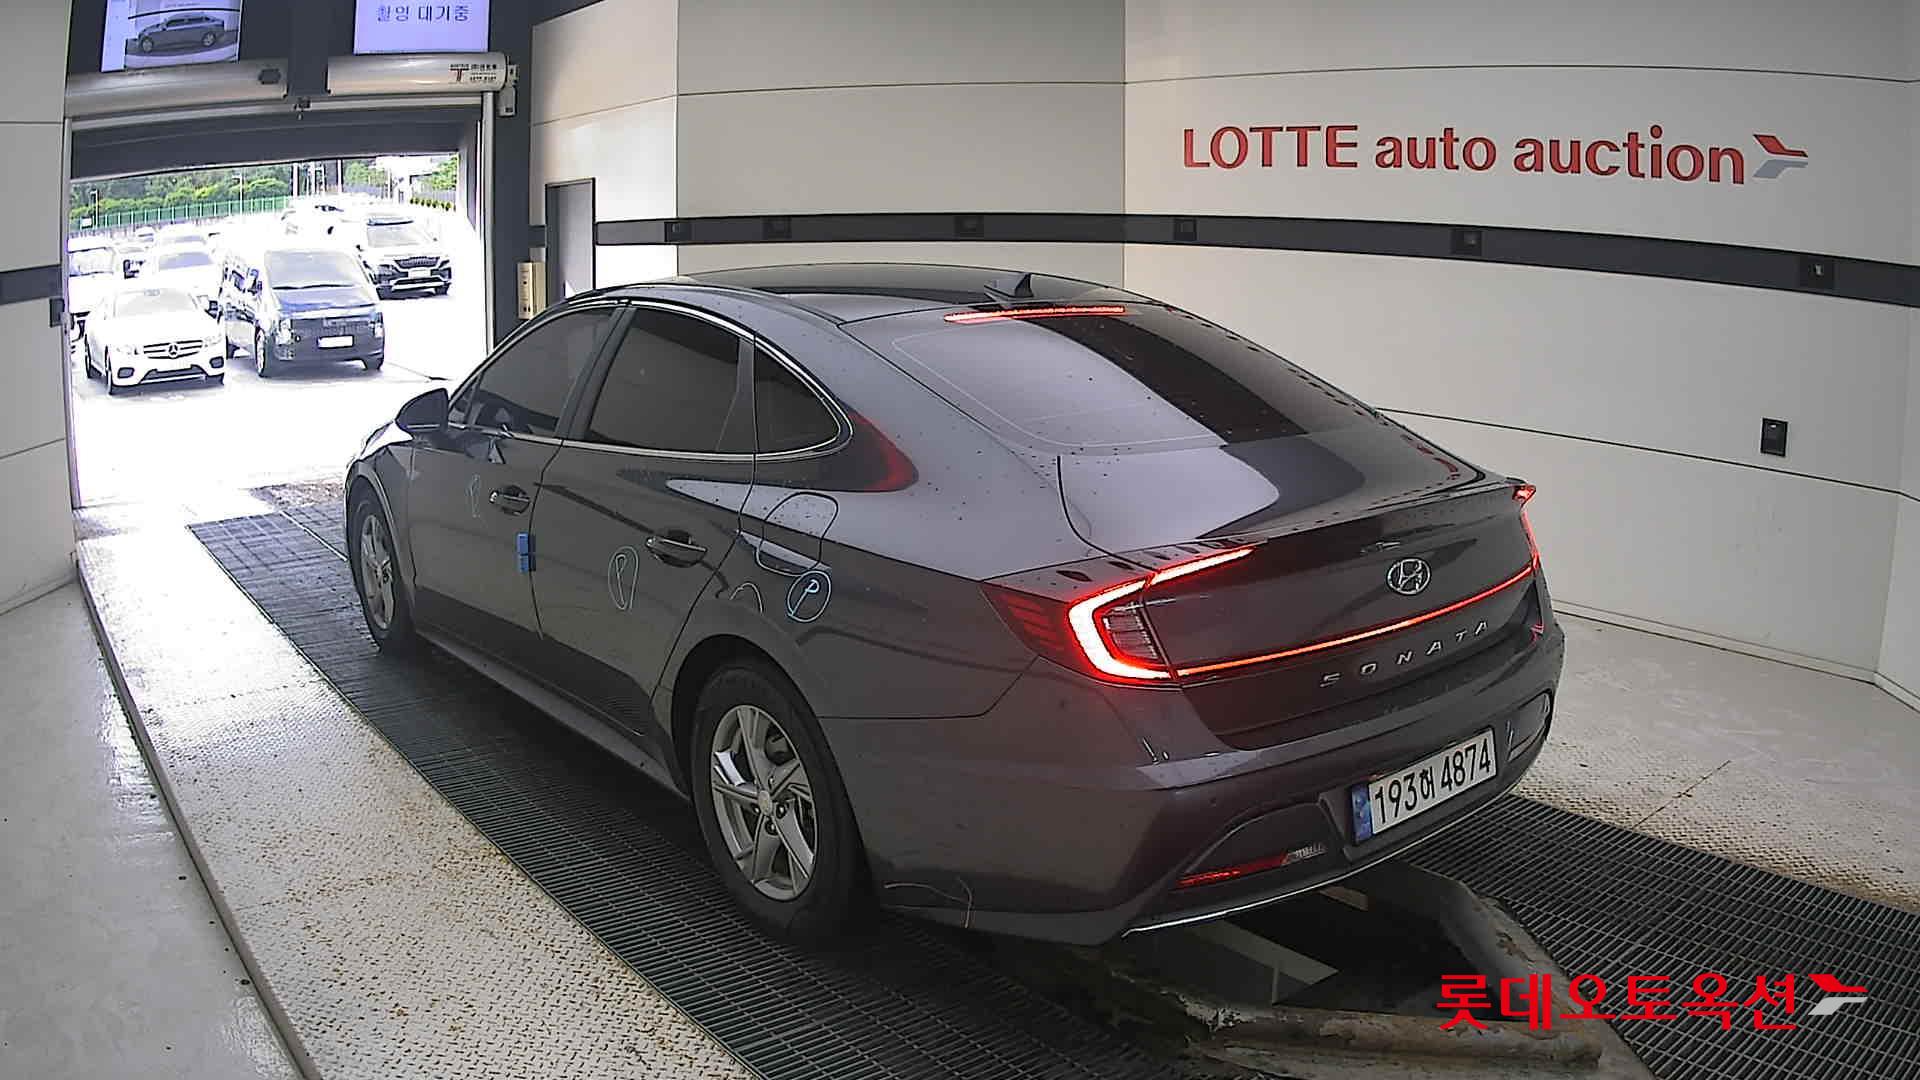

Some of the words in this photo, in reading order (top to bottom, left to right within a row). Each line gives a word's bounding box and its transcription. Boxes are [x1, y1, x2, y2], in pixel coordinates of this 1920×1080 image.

[418, 5, 469, 22] 대기중
[1184, 125, 1358, 168] LOTTE
[1375, 127, 1497, 171] auto
[1514, 125, 1744, 184] auction
[1320, 621, 1488, 687] SONATA
[1375, 766, 1435, 824] 193허
[1441, 738, 1490, 791] 4874
